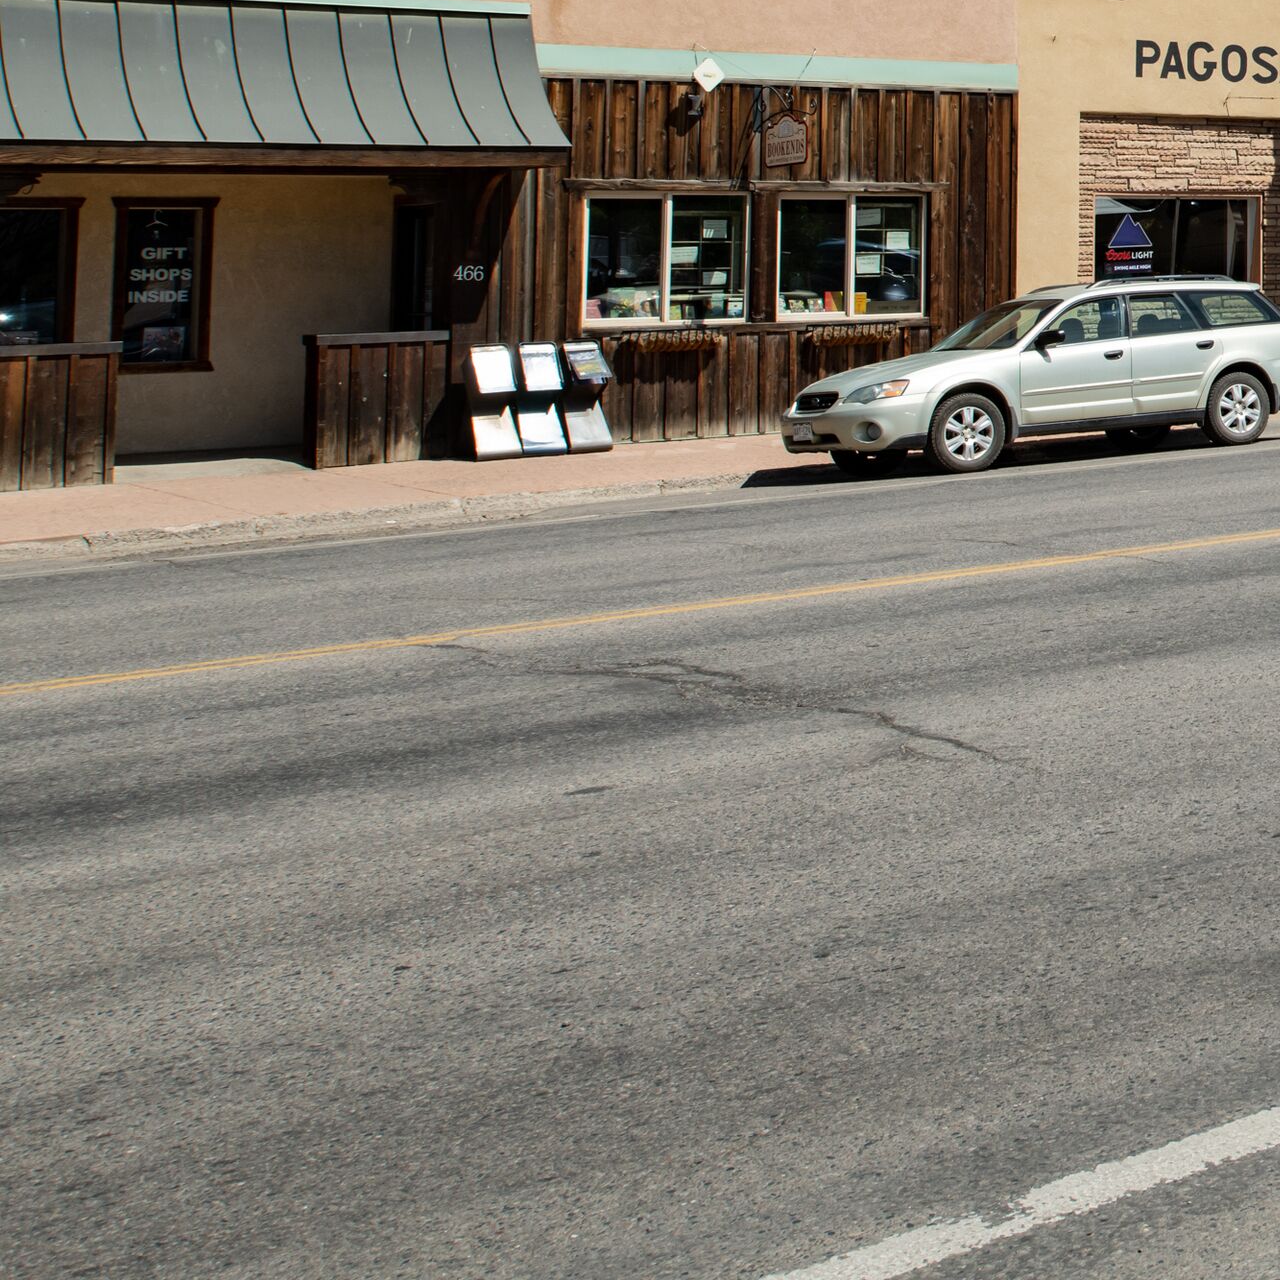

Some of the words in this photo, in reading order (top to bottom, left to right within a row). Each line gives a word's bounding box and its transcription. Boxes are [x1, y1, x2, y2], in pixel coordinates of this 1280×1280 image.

[767, 138, 805, 158] BOOKENDS
[141, 247, 187, 260] GIFT
[1131, 251, 1154, 260] LIGHT
[130, 267, 192, 281] SHOPS
[453, 265, 485, 281] 466
[128, 290, 189, 303] INSIDE
